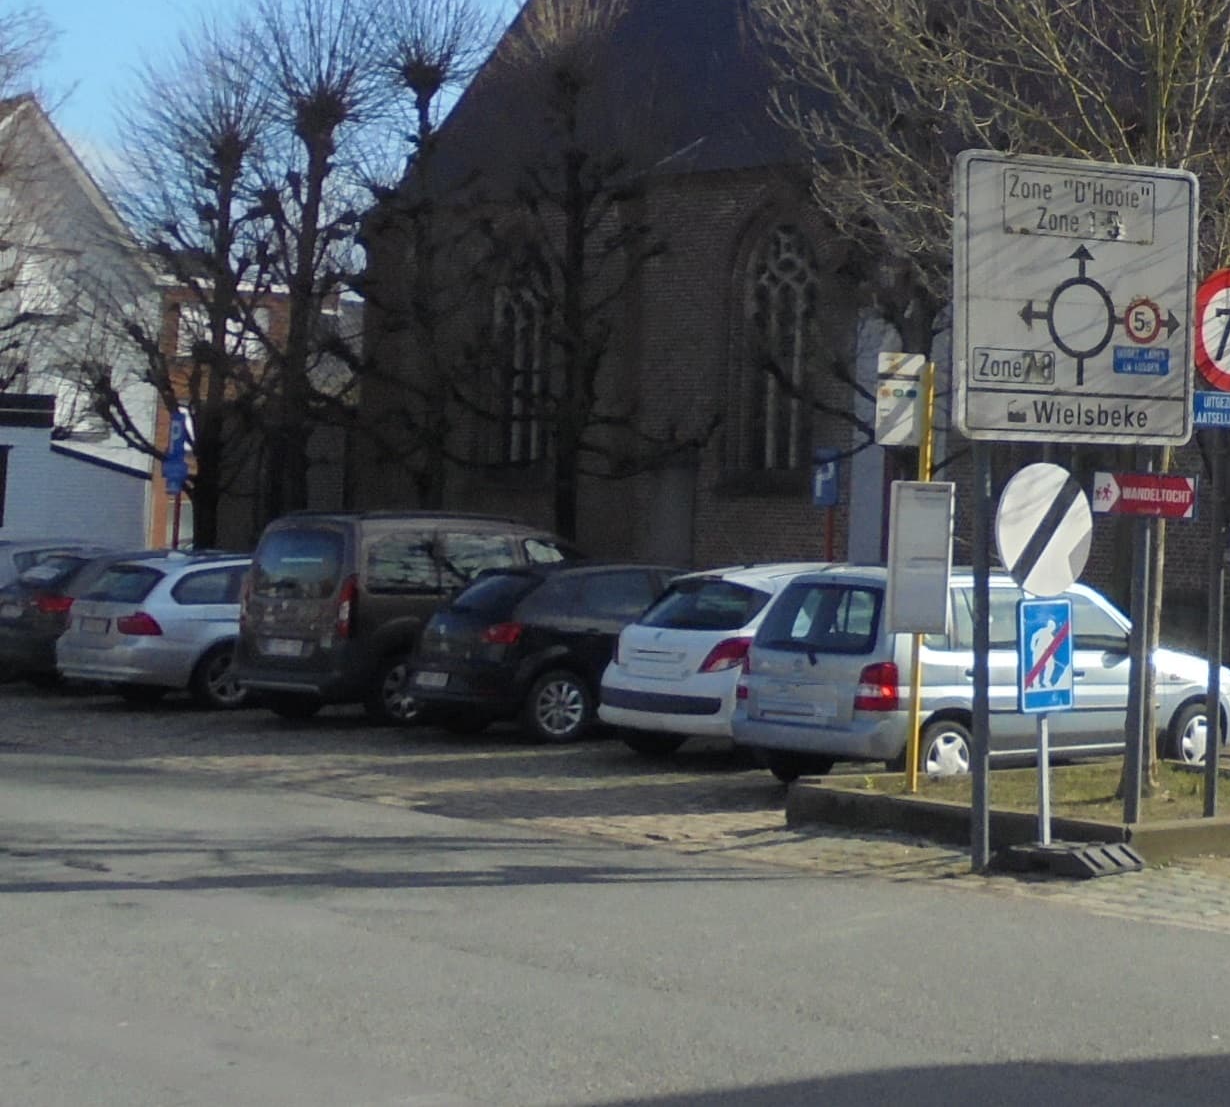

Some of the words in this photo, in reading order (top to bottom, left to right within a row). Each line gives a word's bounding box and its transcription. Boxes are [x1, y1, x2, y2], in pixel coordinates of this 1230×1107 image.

[1008, 174, 1052, 200] Zone
[1037, 207, 1080, 232] Zone
[979, 352, 1022, 378] Zone
[1033, 400, 1148, 428] Wielsbeke
[1122, 486, 1192, 504] WANDELTOCHT
